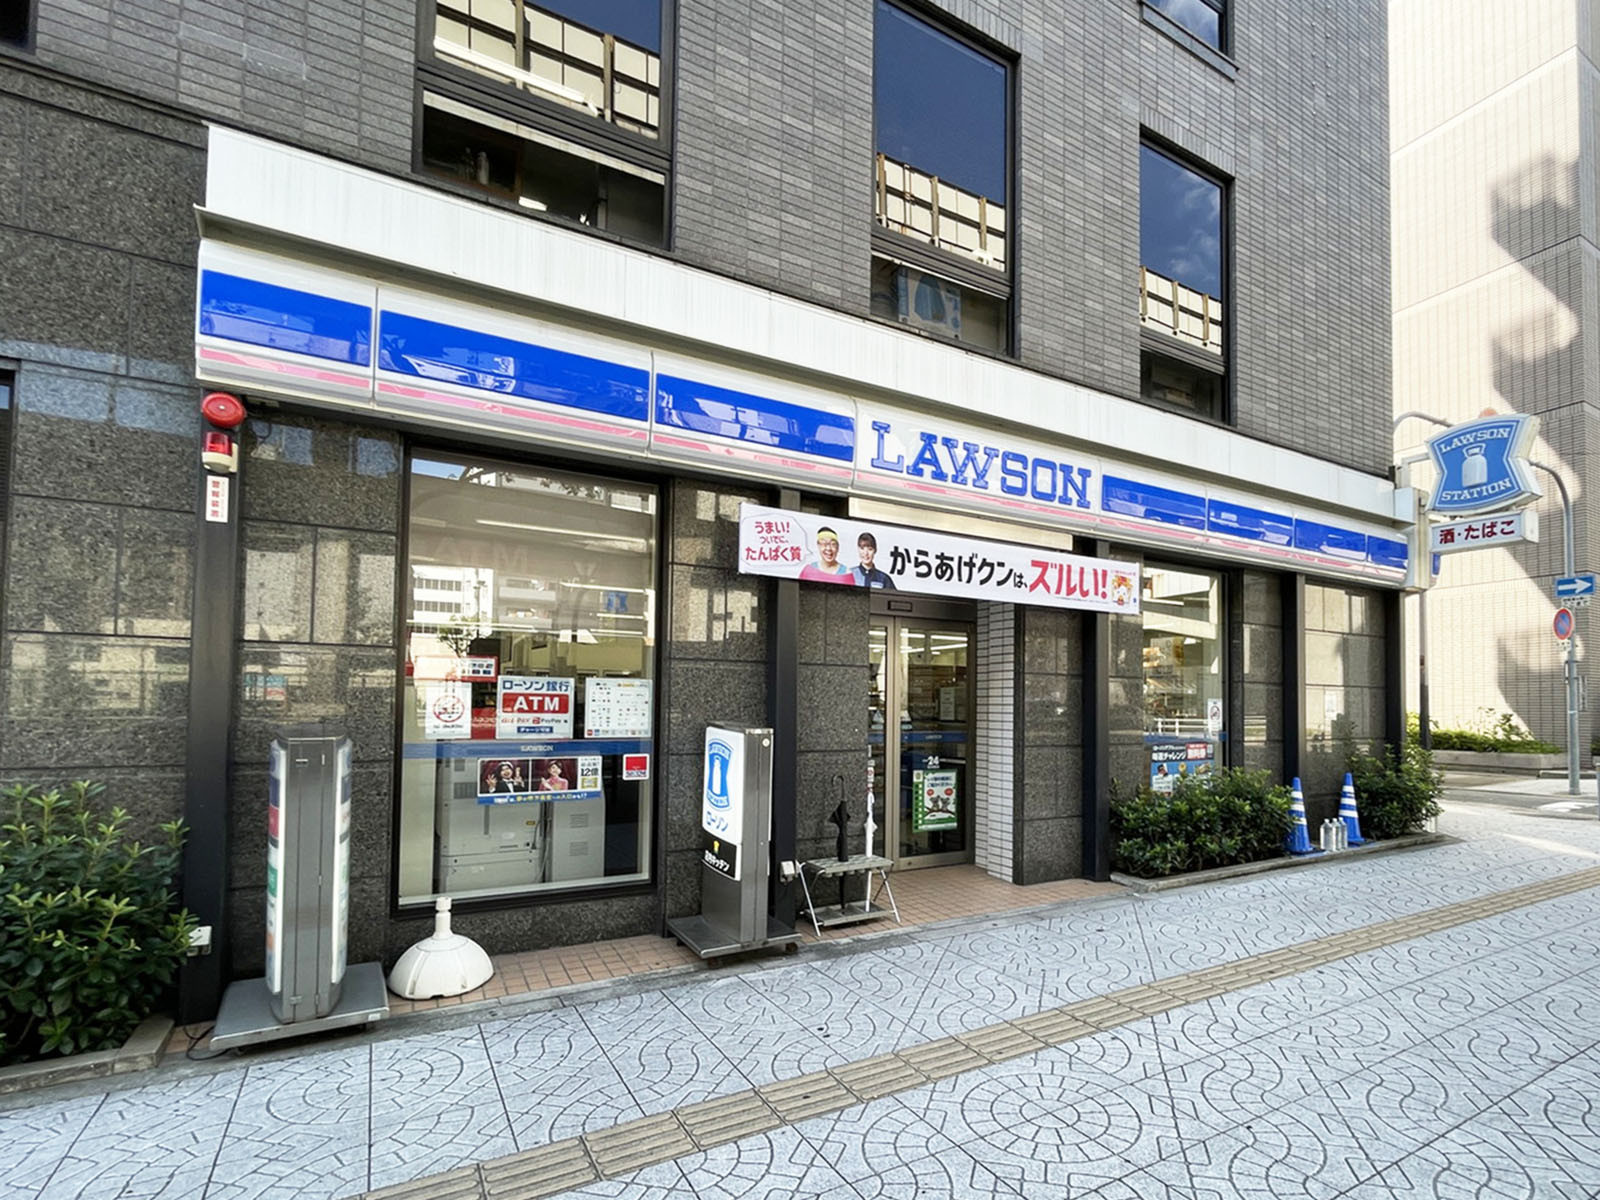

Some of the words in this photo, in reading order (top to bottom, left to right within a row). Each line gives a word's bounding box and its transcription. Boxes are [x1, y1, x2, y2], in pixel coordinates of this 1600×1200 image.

[1440, 427, 1511, 454] LAWSON
[871, 420, 1092, 509] LAWSON
[1441, 478, 1512, 502] STATION
[754, 521, 790, 534] うまい!
[1439, 519, 1515, 545] 酒・たばこ
[745, 546, 802, 562] たんぱく質
[502, 680, 570, 692] ローソン銀行
[513, 695, 560, 711] ATM
[928, 755, 940, 766] 24
